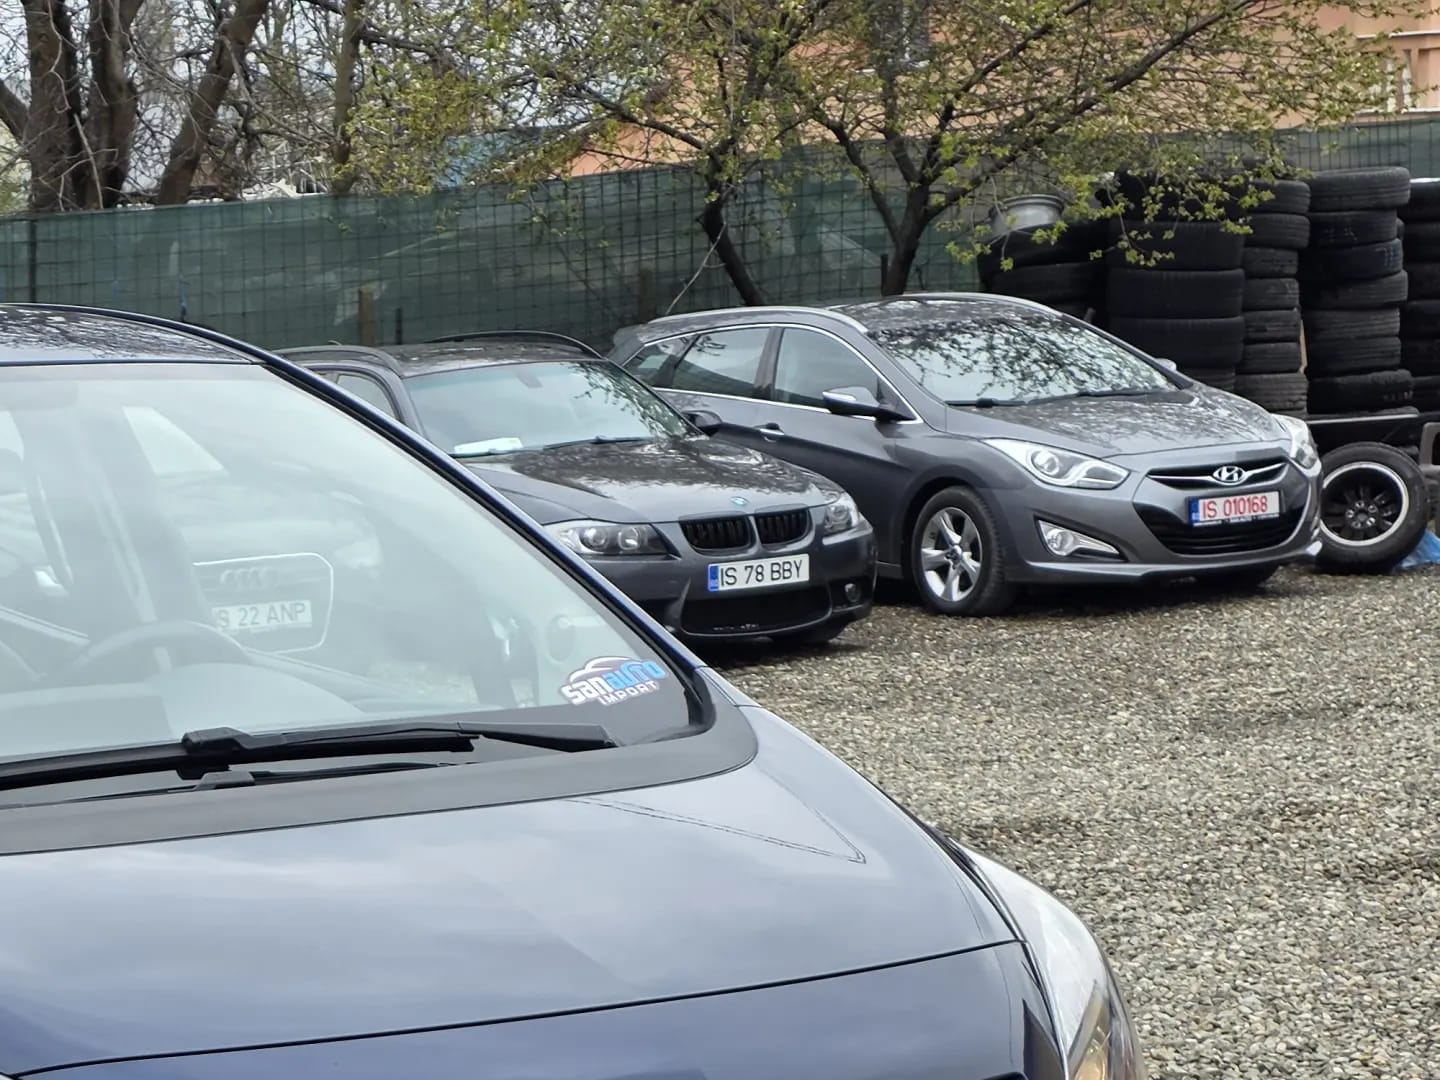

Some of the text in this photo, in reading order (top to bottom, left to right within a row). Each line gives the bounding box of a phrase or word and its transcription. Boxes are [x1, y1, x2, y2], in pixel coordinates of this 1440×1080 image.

[1203, 495, 1268, 519] IS 010168
[720, 560, 803, 587] IS 78 BBY
[238, 606, 260, 626] 22
[598, 680, 658, 706] IMPORT
